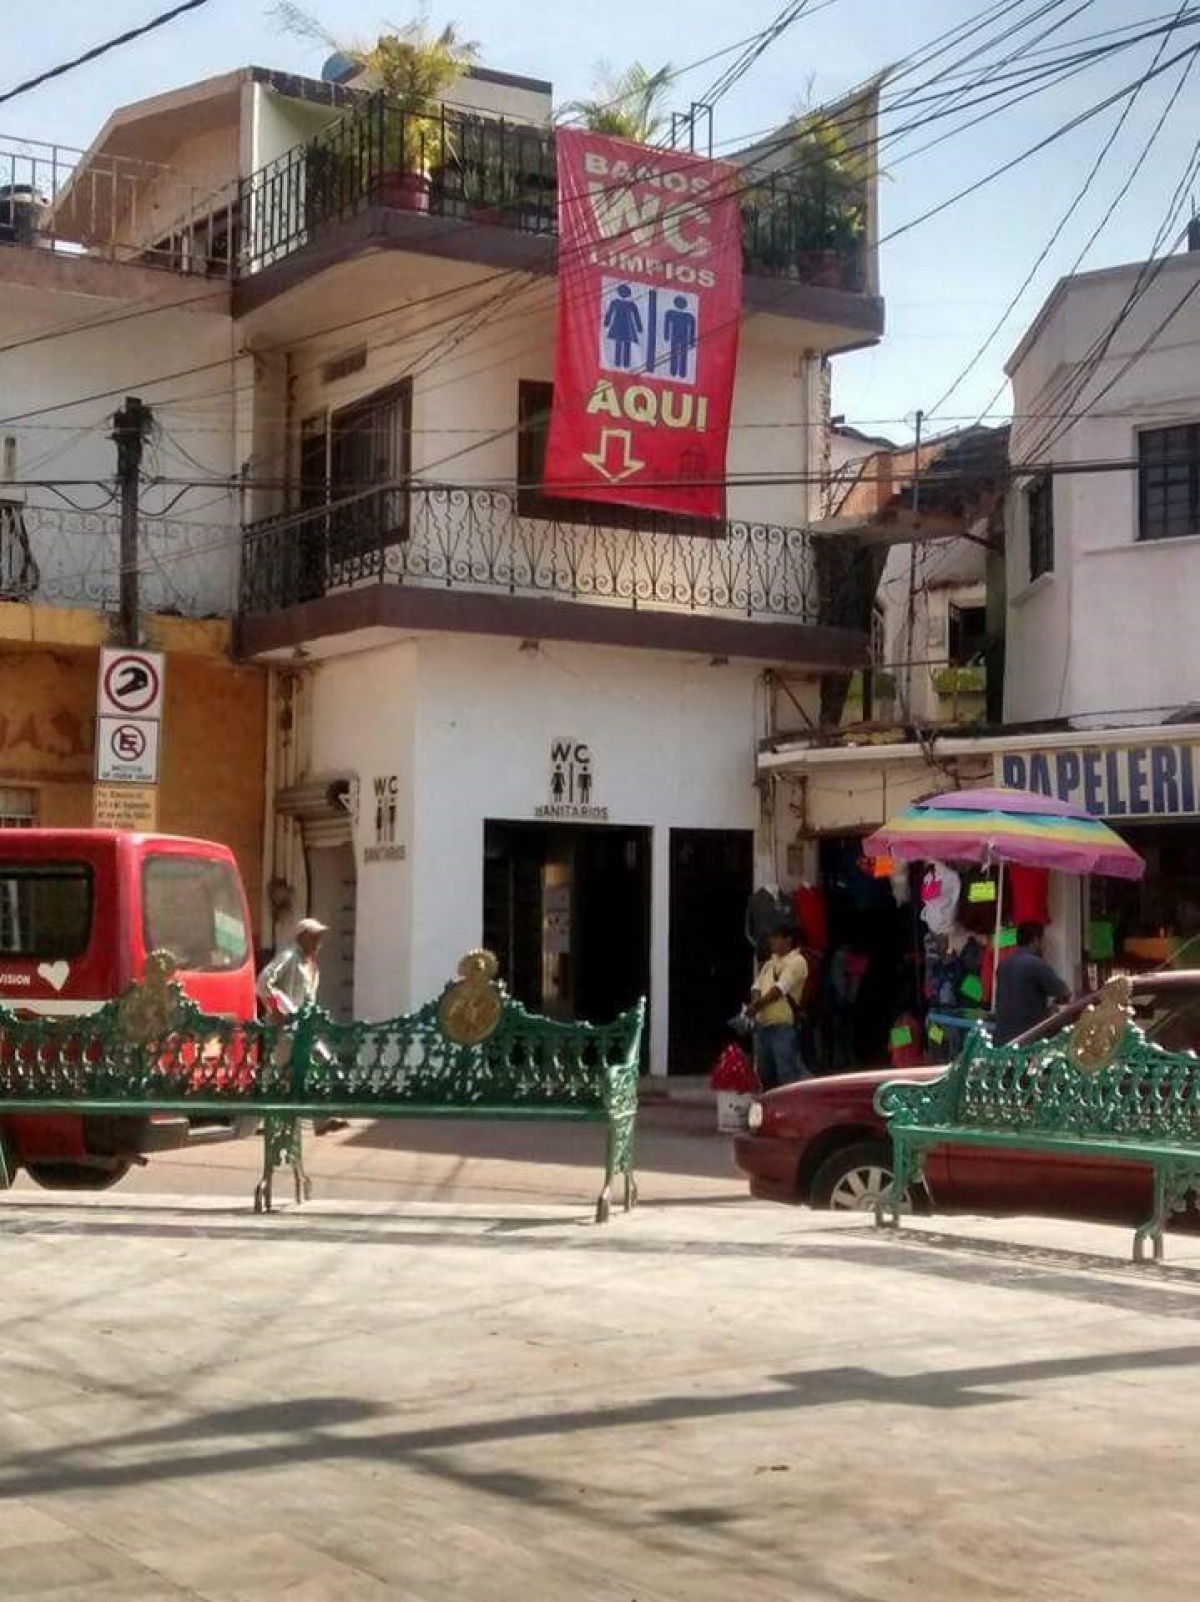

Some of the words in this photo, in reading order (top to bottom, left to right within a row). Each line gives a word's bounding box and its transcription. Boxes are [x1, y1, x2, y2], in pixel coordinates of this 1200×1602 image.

[587, 181, 711, 258] WC
[586, 379, 708, 433] AQUI
[551, 743, 590, 763] WC
[374, 775, 398, 796] WC
